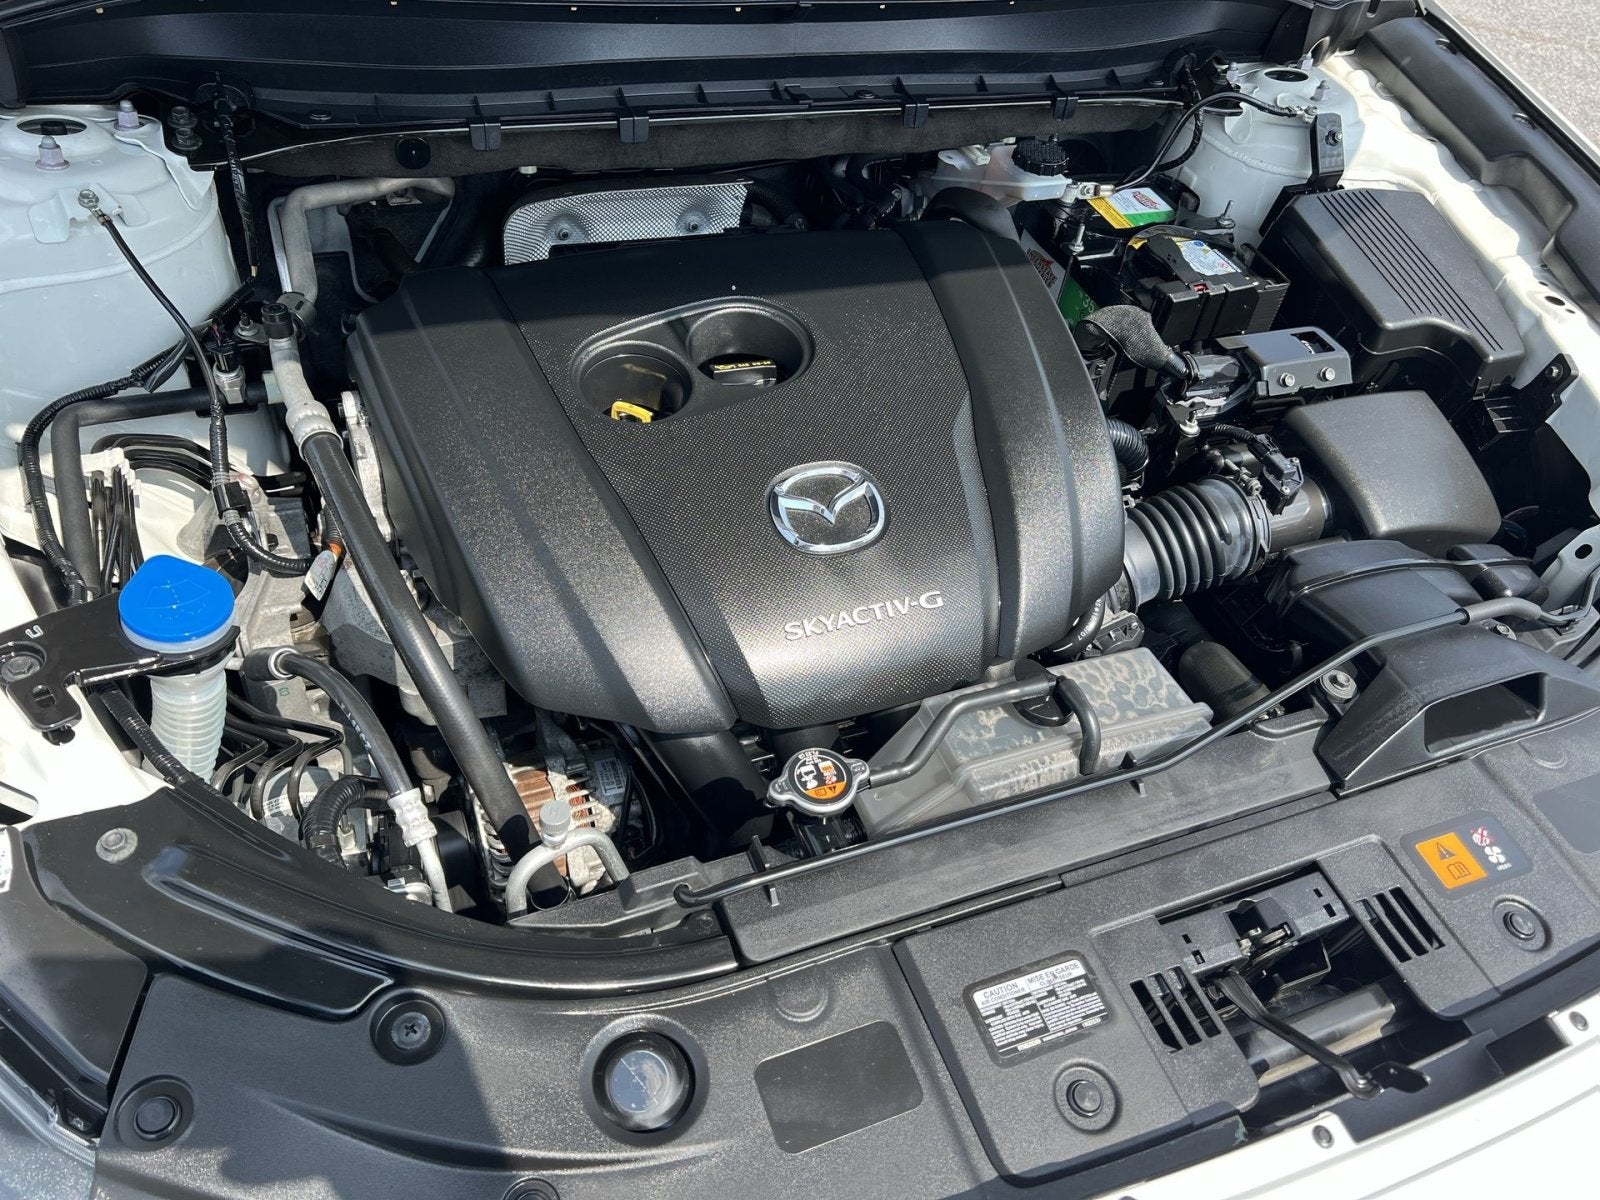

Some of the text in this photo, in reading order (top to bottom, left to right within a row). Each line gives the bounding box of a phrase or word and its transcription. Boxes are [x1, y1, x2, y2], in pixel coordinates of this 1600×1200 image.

[784, 590, 945, 641] SKYACTIV-G
[1027, 962, 1080, 984] MISE EN GARDE
[983, 981, 1019, 998] CAUTION
